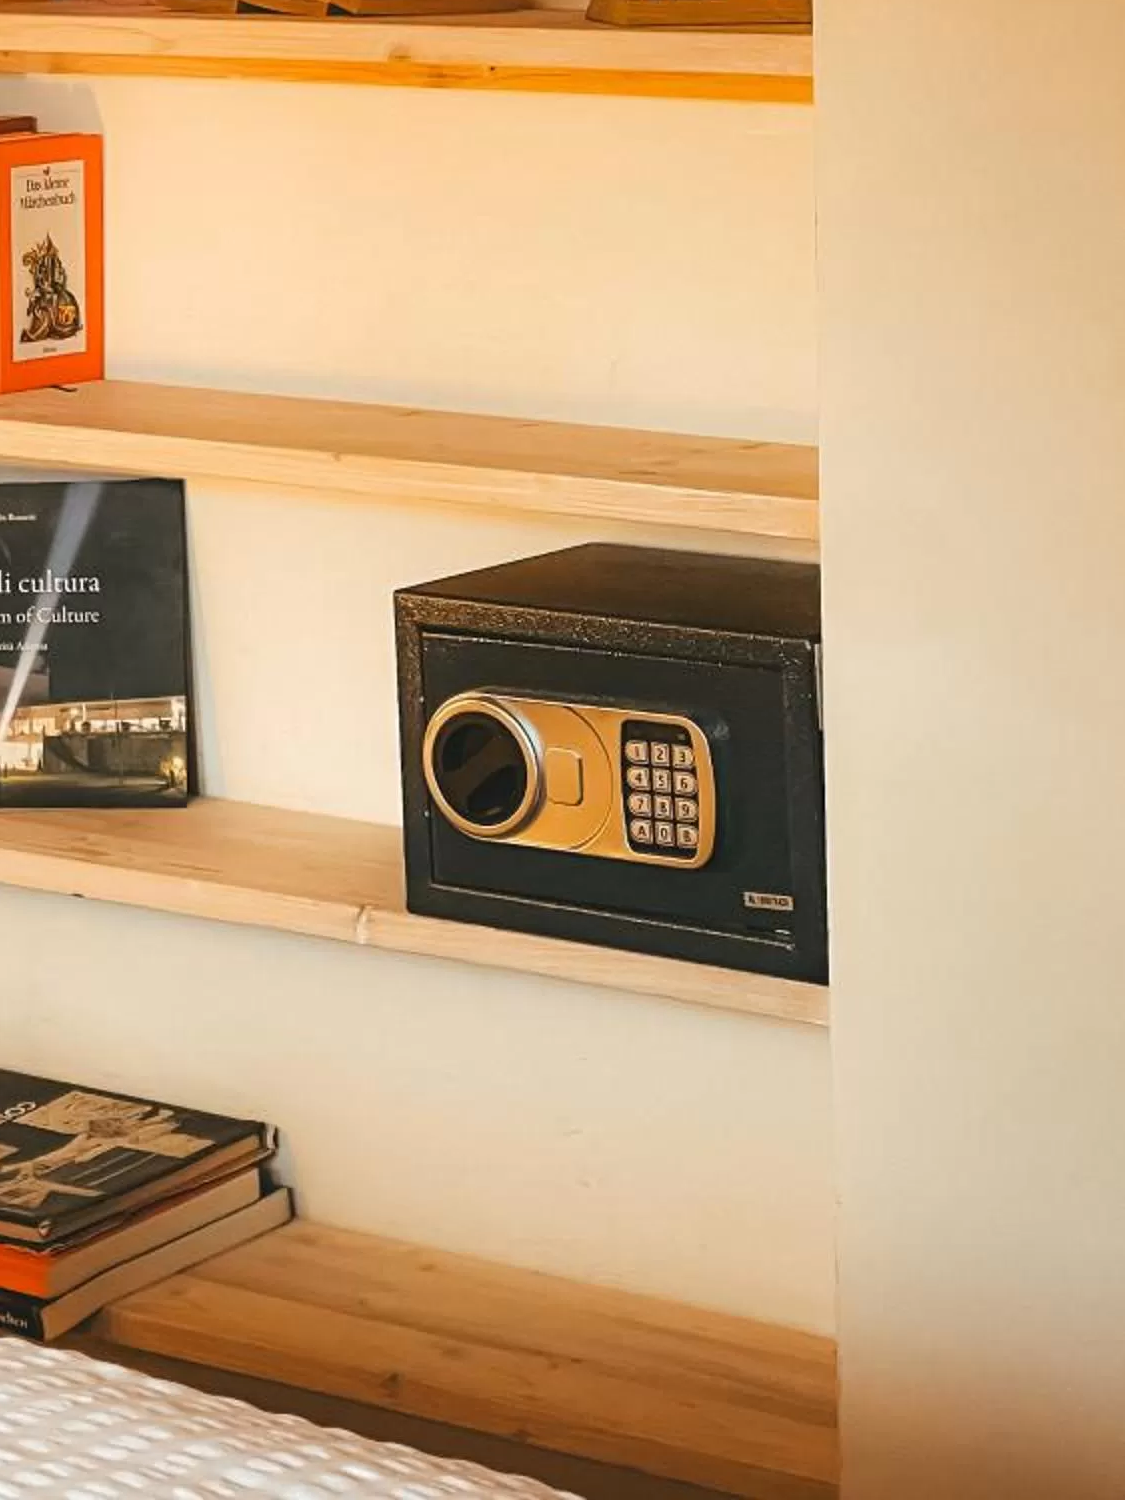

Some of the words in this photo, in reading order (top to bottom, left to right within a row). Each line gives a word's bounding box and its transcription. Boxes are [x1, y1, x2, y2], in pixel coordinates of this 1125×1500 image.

[18, 569, 100, 594] cultura
[16, 606, 34, 625] of
[35, 607, 100, 624] Culture
